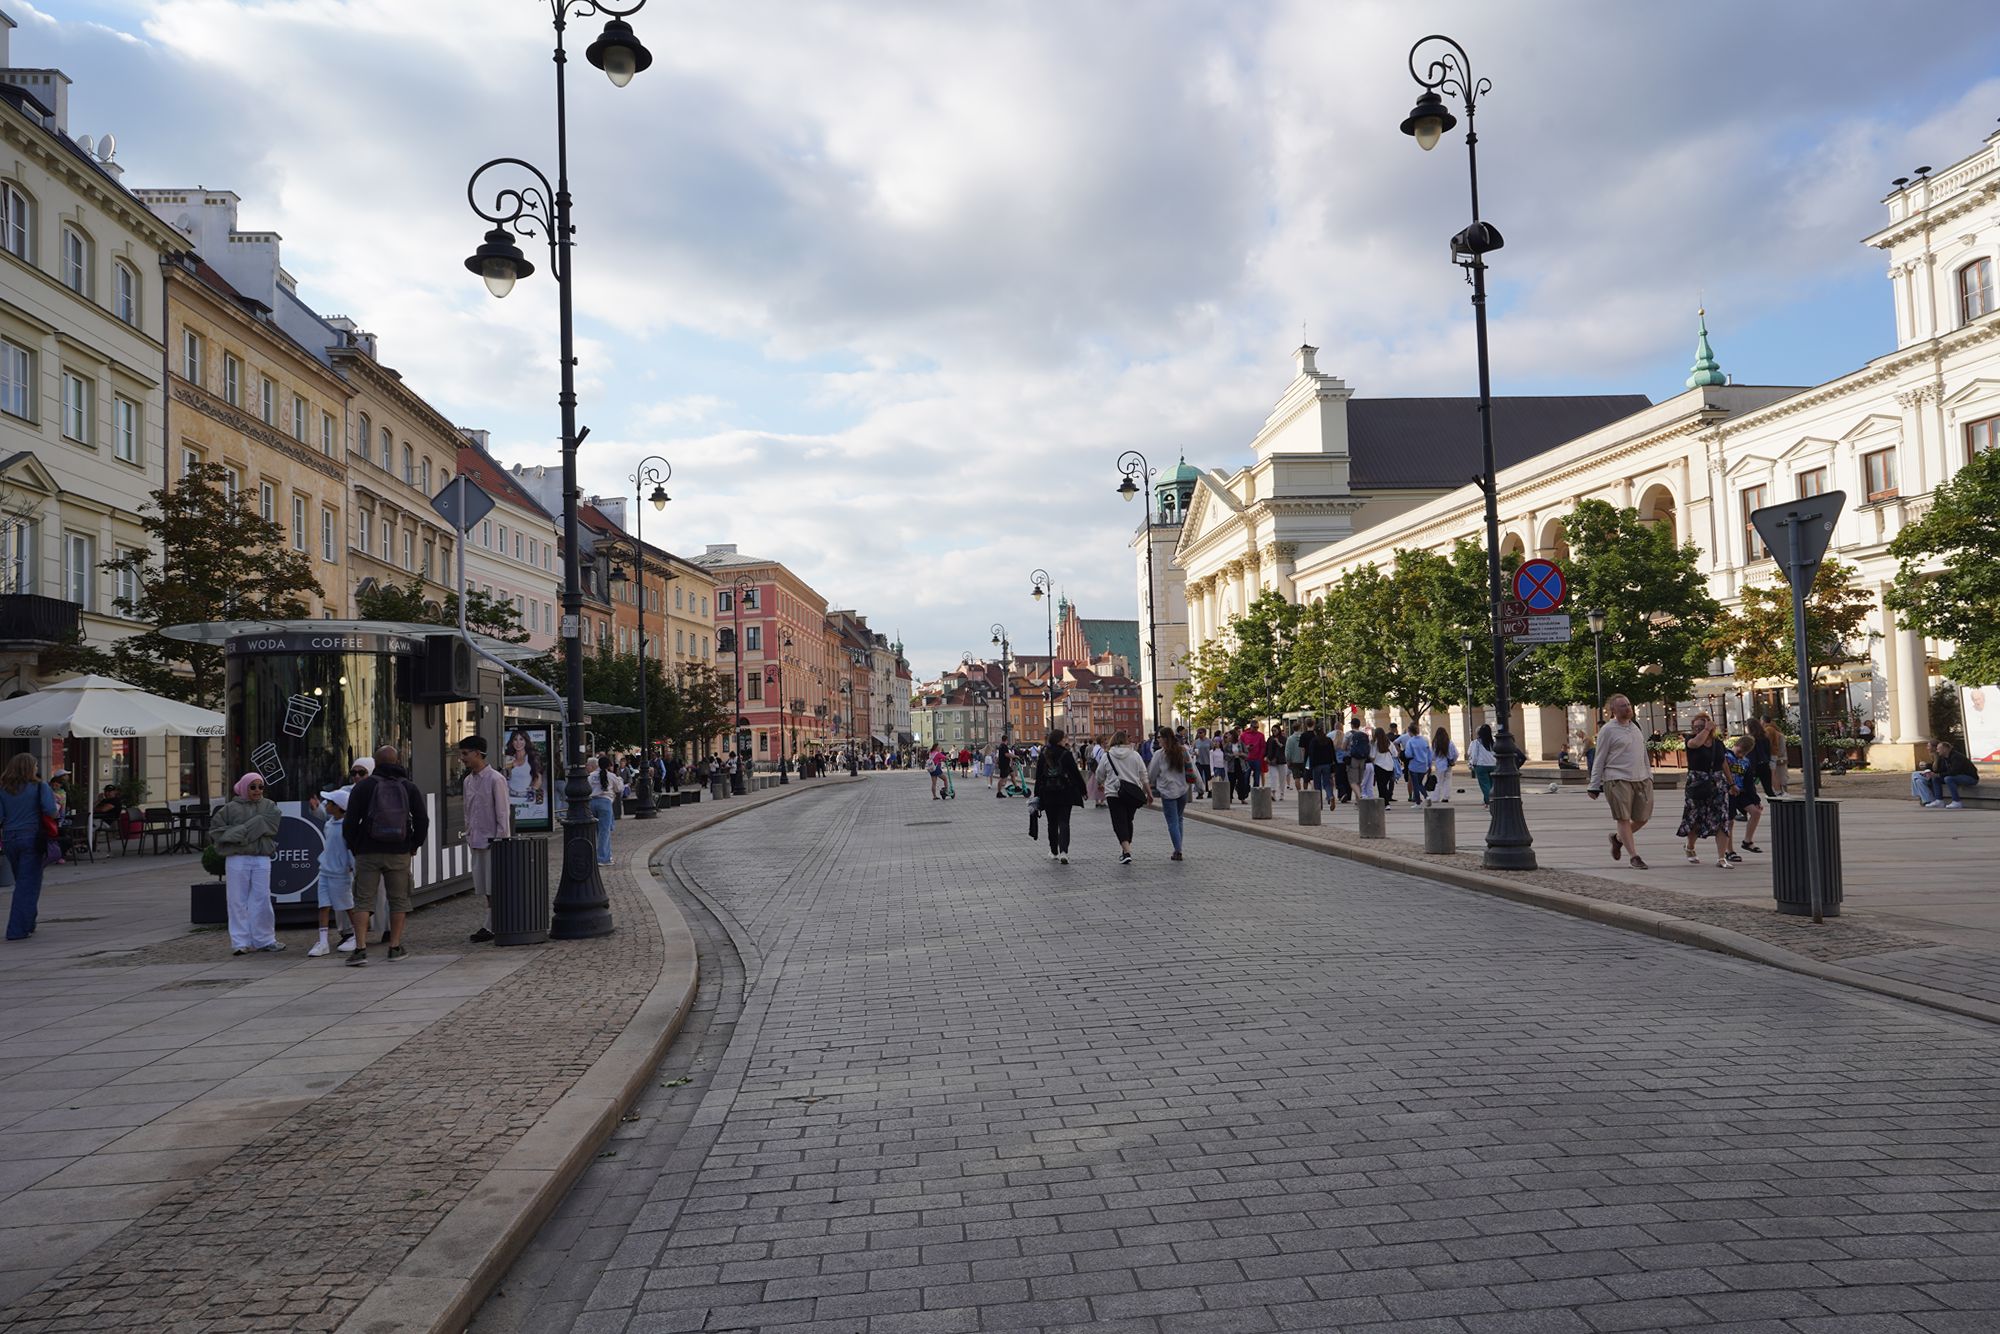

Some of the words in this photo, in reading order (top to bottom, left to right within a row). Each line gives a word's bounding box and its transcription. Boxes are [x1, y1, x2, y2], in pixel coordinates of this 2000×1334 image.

[1503, 623, 1517, 633] WC
[247, 639, 286, 650] WODA
[311, 637, 363, 649] COFFEE
[388, 640, 412, 652] KAWA
[270, 849, 309, 862] OFFEE
